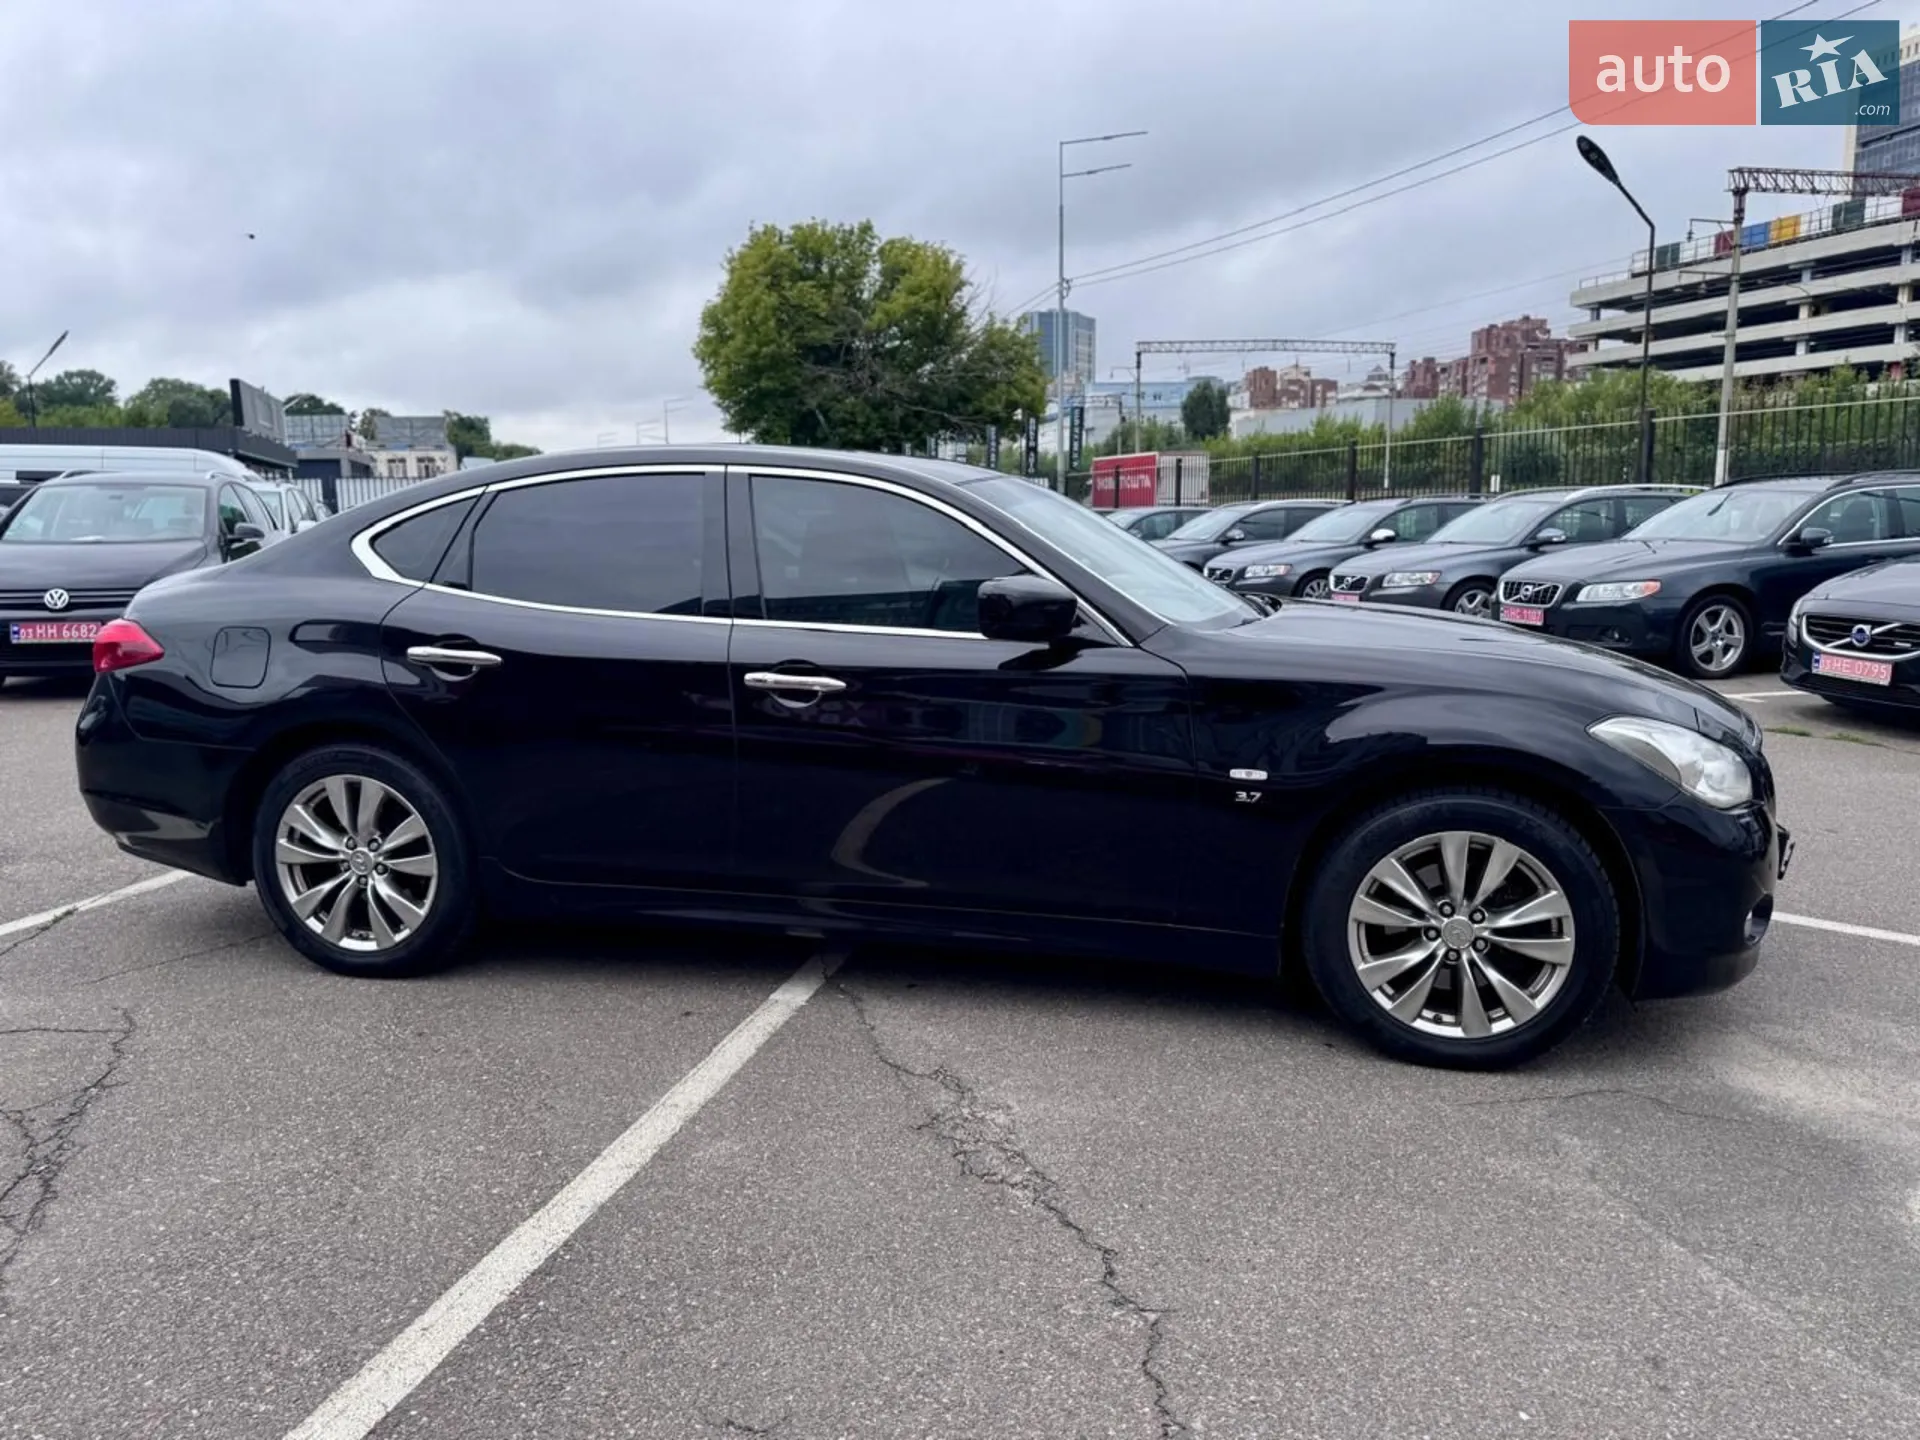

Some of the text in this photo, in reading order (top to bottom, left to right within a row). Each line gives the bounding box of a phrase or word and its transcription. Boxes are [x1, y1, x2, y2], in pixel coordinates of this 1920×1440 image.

[62, 624, 97, 638] 6682
[1855, 661, 1888, 679] 0795
[1235, 791, 1262, 804] 3.7
